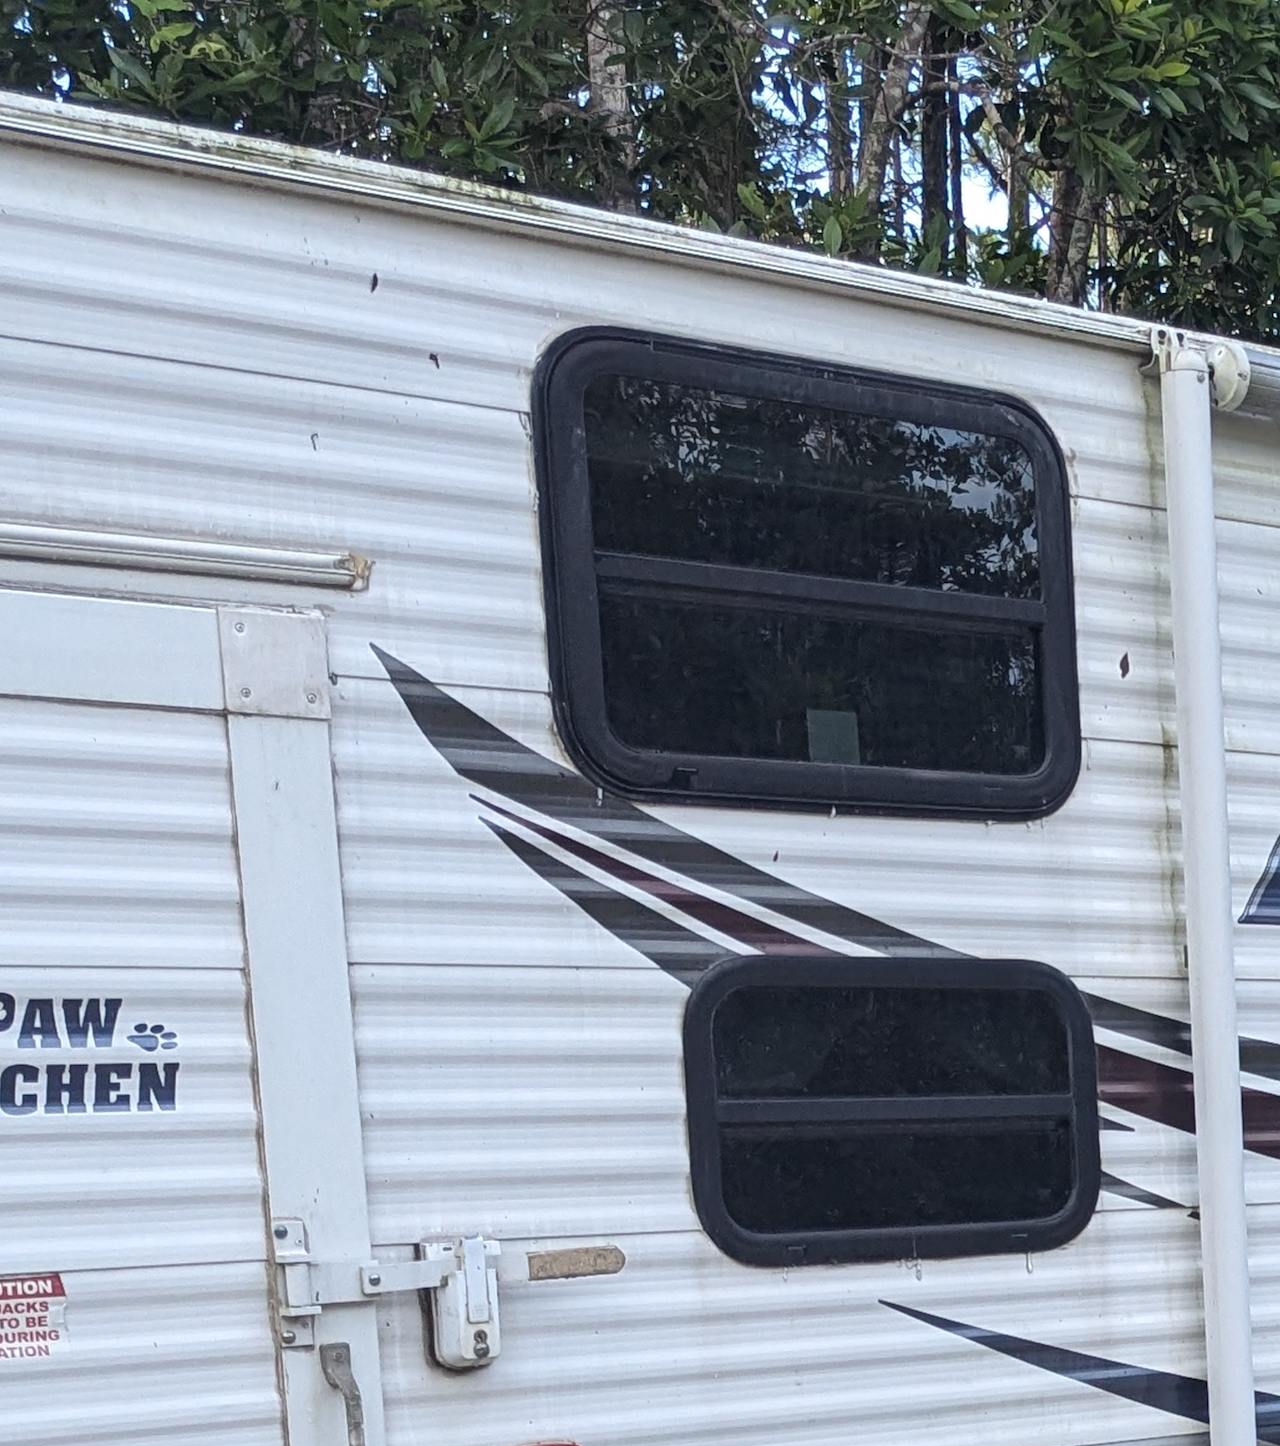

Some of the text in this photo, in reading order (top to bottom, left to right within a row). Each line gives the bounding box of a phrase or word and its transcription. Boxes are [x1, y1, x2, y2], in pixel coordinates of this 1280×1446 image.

[0, 1062, 180, 1116] CHEN
[0, 1280, 53, 1296] TION
[0, 1301, 49, 1315] ACKS
[26, 1316, 48, 1328] BE
[0, 1330, 60, 1344] URING
